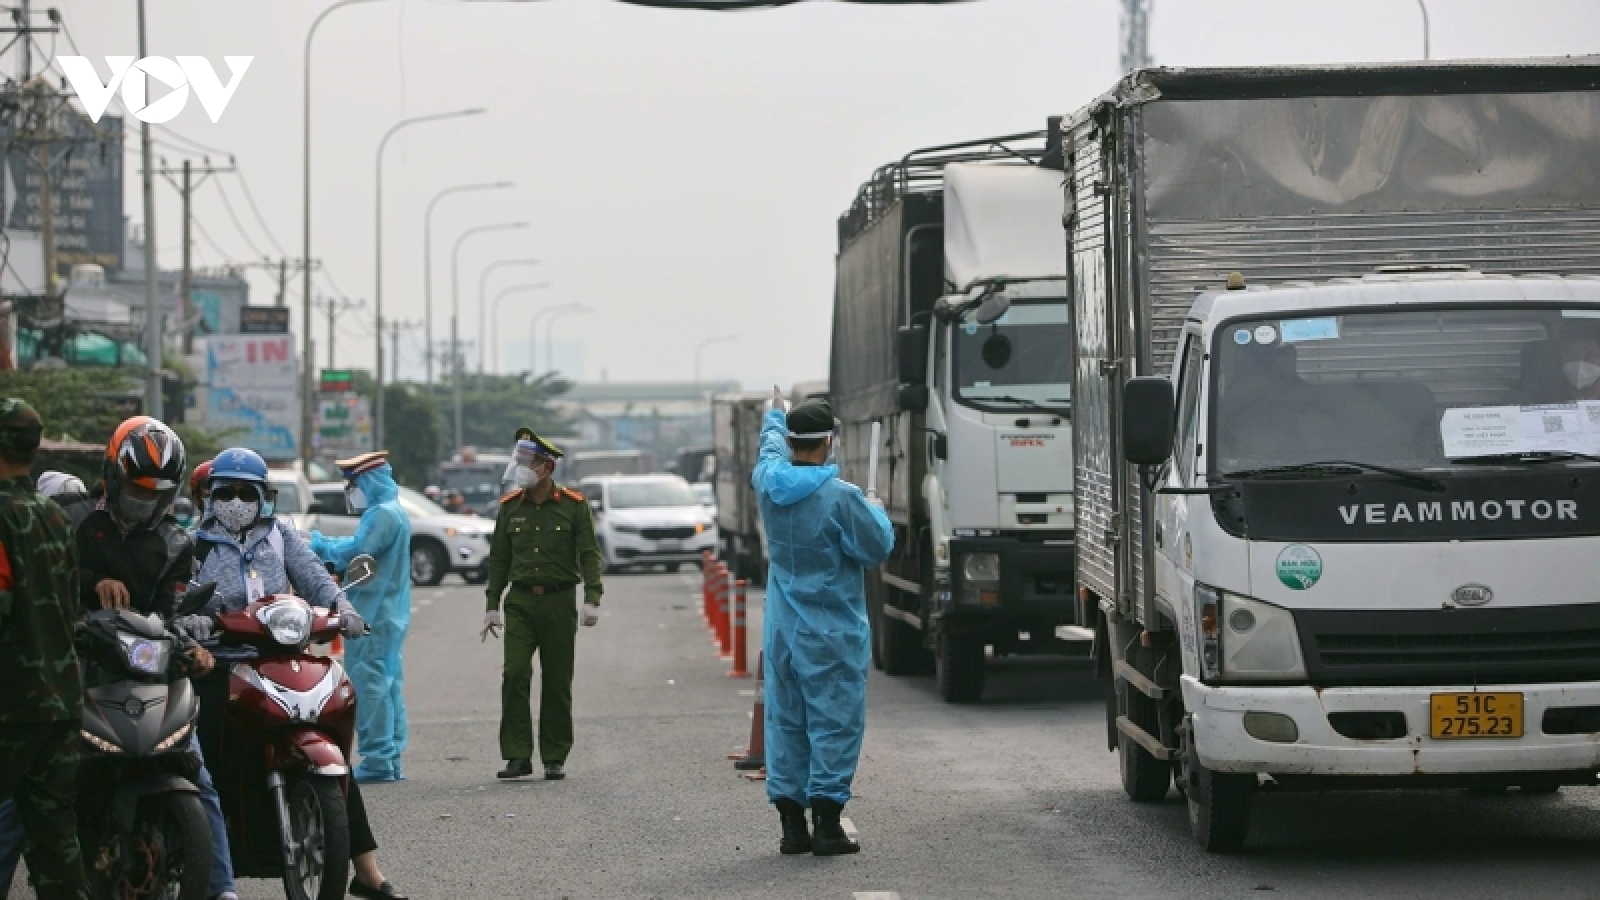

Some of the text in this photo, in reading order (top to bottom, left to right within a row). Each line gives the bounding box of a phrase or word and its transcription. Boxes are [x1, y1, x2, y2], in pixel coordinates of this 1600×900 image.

[246, 340, 288, 364] IN
[1338, 499, 1579, 525] VEAM MOTOR
[1456, 695, 1497, 715] 51C
[1441, 717, 1514, 735] 275.23
